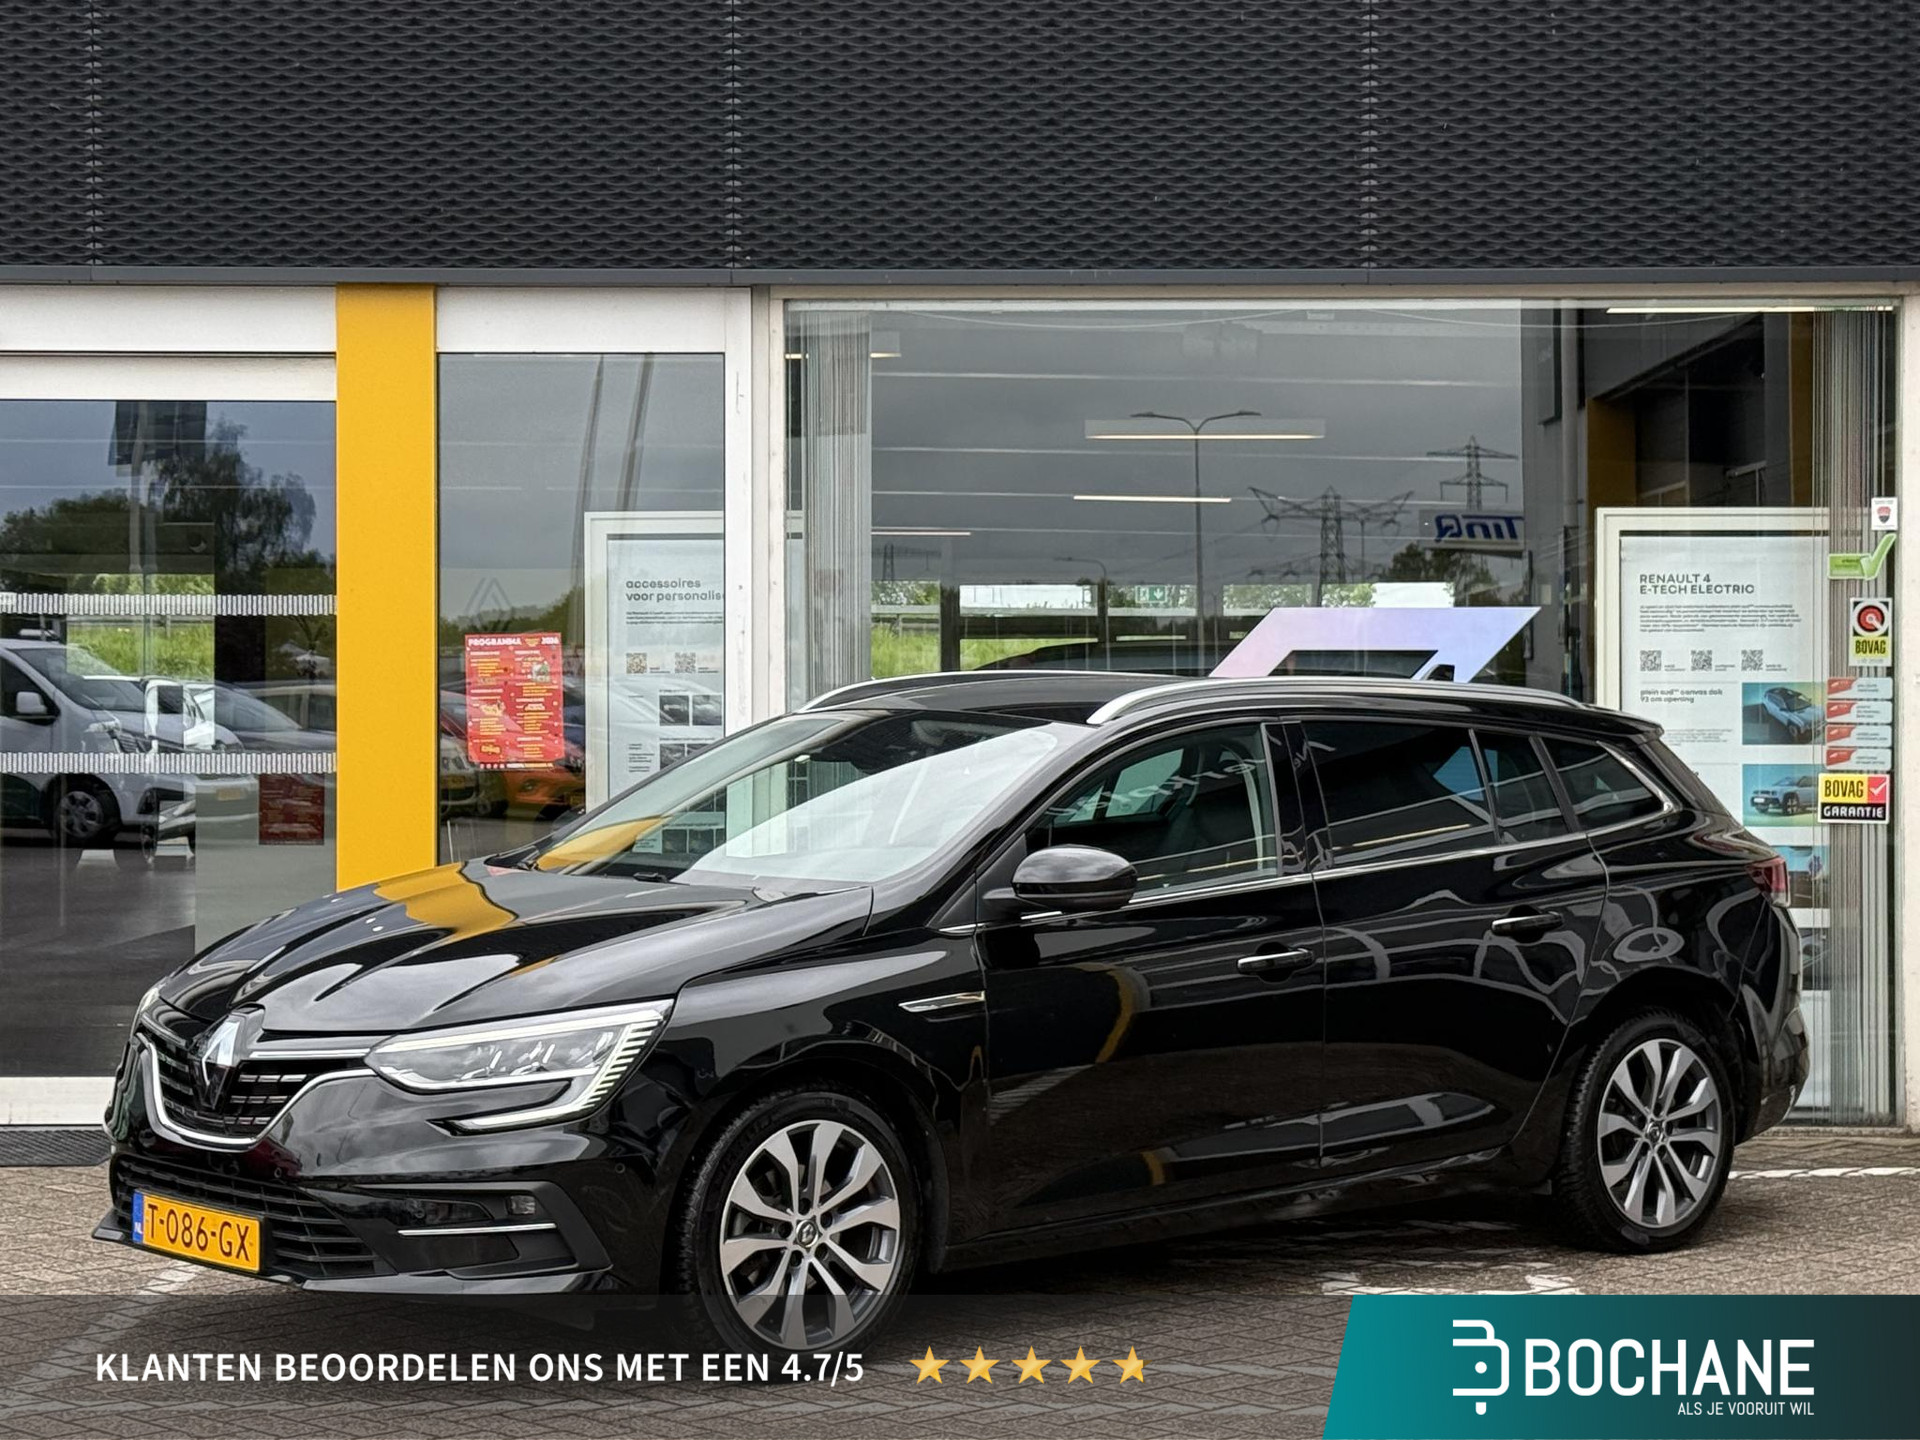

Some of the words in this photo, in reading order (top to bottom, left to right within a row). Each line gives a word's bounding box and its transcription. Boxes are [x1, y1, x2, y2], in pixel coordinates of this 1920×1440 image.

[625, 577, 702, 589] accessoires
[1639, 573, 1701, 584] RENAULT
[1702, 573, 1711, 583] 4
[1639, 584, 1688, 595] E-TECH
[1690, 584, 1755, 595] ELECTRIC
[625, 592, 654, 602] voor
[1855, 639, 1886, 655] BOVAG
[1824, 779, 1864, 799] BOVAG
[1823, 805, 1885, 819] GARANTIE
[147, 1203, 250, 1262] T-086-GX
